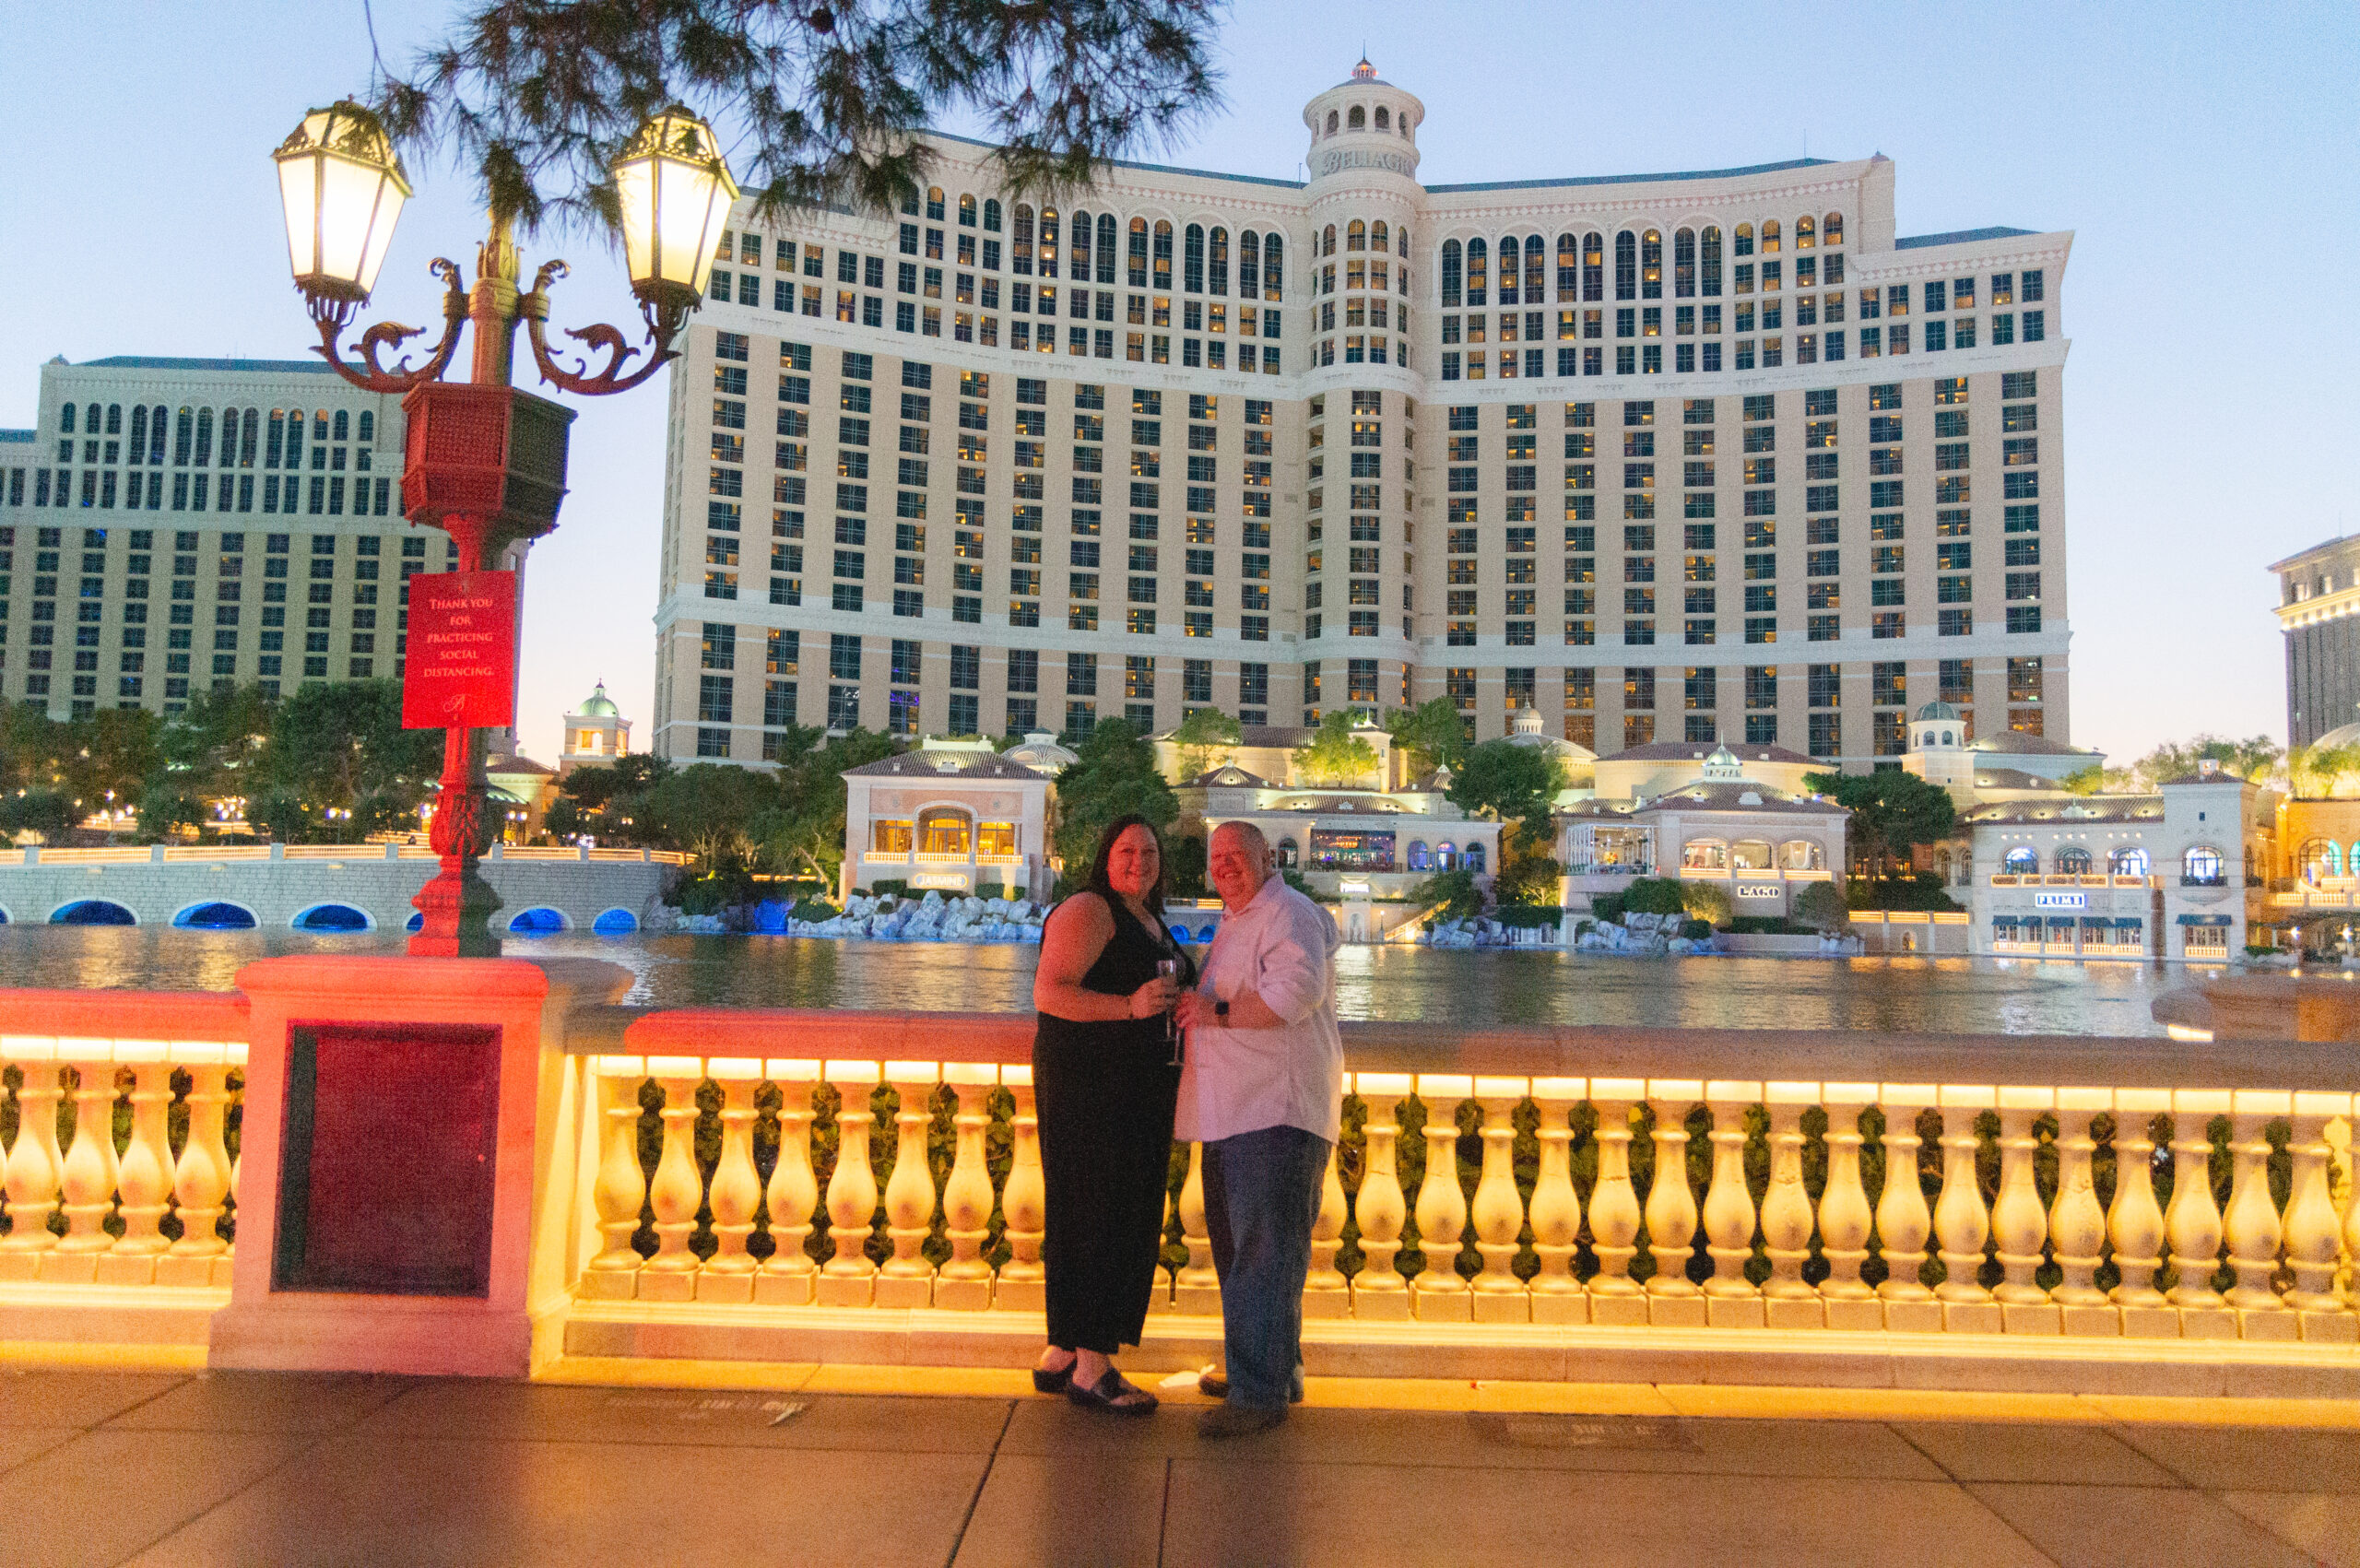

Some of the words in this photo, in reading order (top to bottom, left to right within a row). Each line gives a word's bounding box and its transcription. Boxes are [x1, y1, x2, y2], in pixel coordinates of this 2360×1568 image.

[429, 599, 467, 609] THANK
[470, 598, 493, 607] YOU
[450, 616, 472, 626] FOR
[427, 632, 493, 643] PRACTICING
[440, 650, 478, 660] SOCIAL
[919, 875, 962, 886] JASMINE
[1738, 886, 1779, 898] LAGO
[2038, 895, 2081, 905] PRIME
